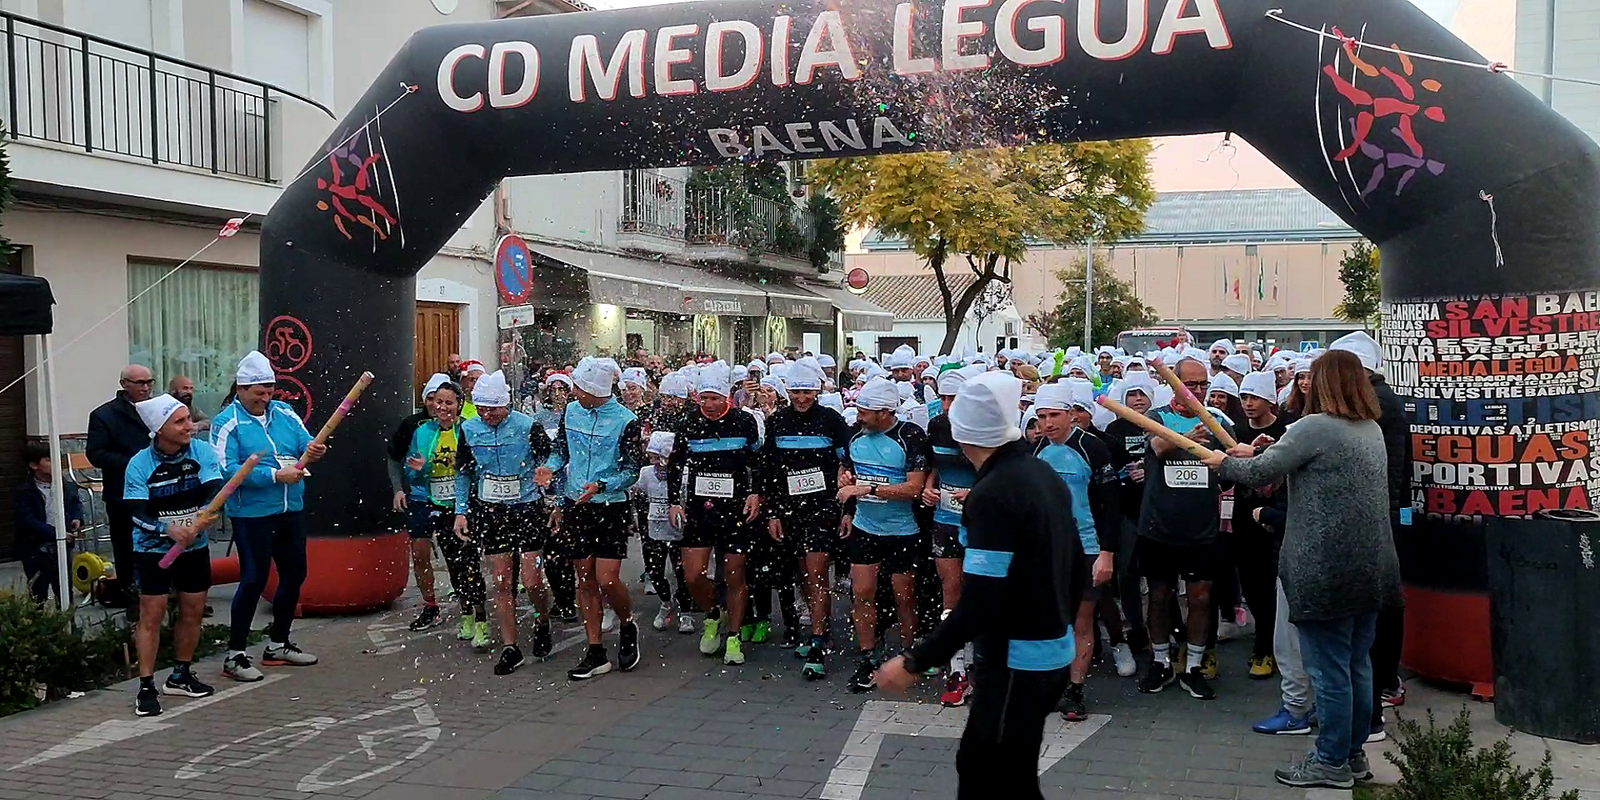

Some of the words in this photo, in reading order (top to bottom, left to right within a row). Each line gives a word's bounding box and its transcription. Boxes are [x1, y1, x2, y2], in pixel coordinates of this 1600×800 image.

[437, 41, 541, 113] CD
[568, 10, 861, 103] MEDIA
[893, 0, 1233, 75] LEGUA
[706, 116, 915, 158] BAENA
[1391, 303, 1440, 320] CARRERA
[1445, 296, 1528, 320] SAN
[1536, 291, 1600, 315] BAE
[1427, 312, 1600, 338] SILVESTRE
[1437, 343, 1542, 355] SILVESTRE
[1419, 360, 1488, 377] MEDIA
[1491, 355, 1580, 375] LEGUA
[1413, 386, 1523, 400] SILVESTRE
[1524, 385, 1576, 398] BAENA
[1409, 423, 1506, 436] DEPORTIVAS
[1508, 419, 1597, 436] ATLETISMO
[1175, 470, 1198, 480] 206
[492, 483, 512, 494] 213
[708, 481, 722, 491] 36
[1428, 485, 1589, 516] BAENA
